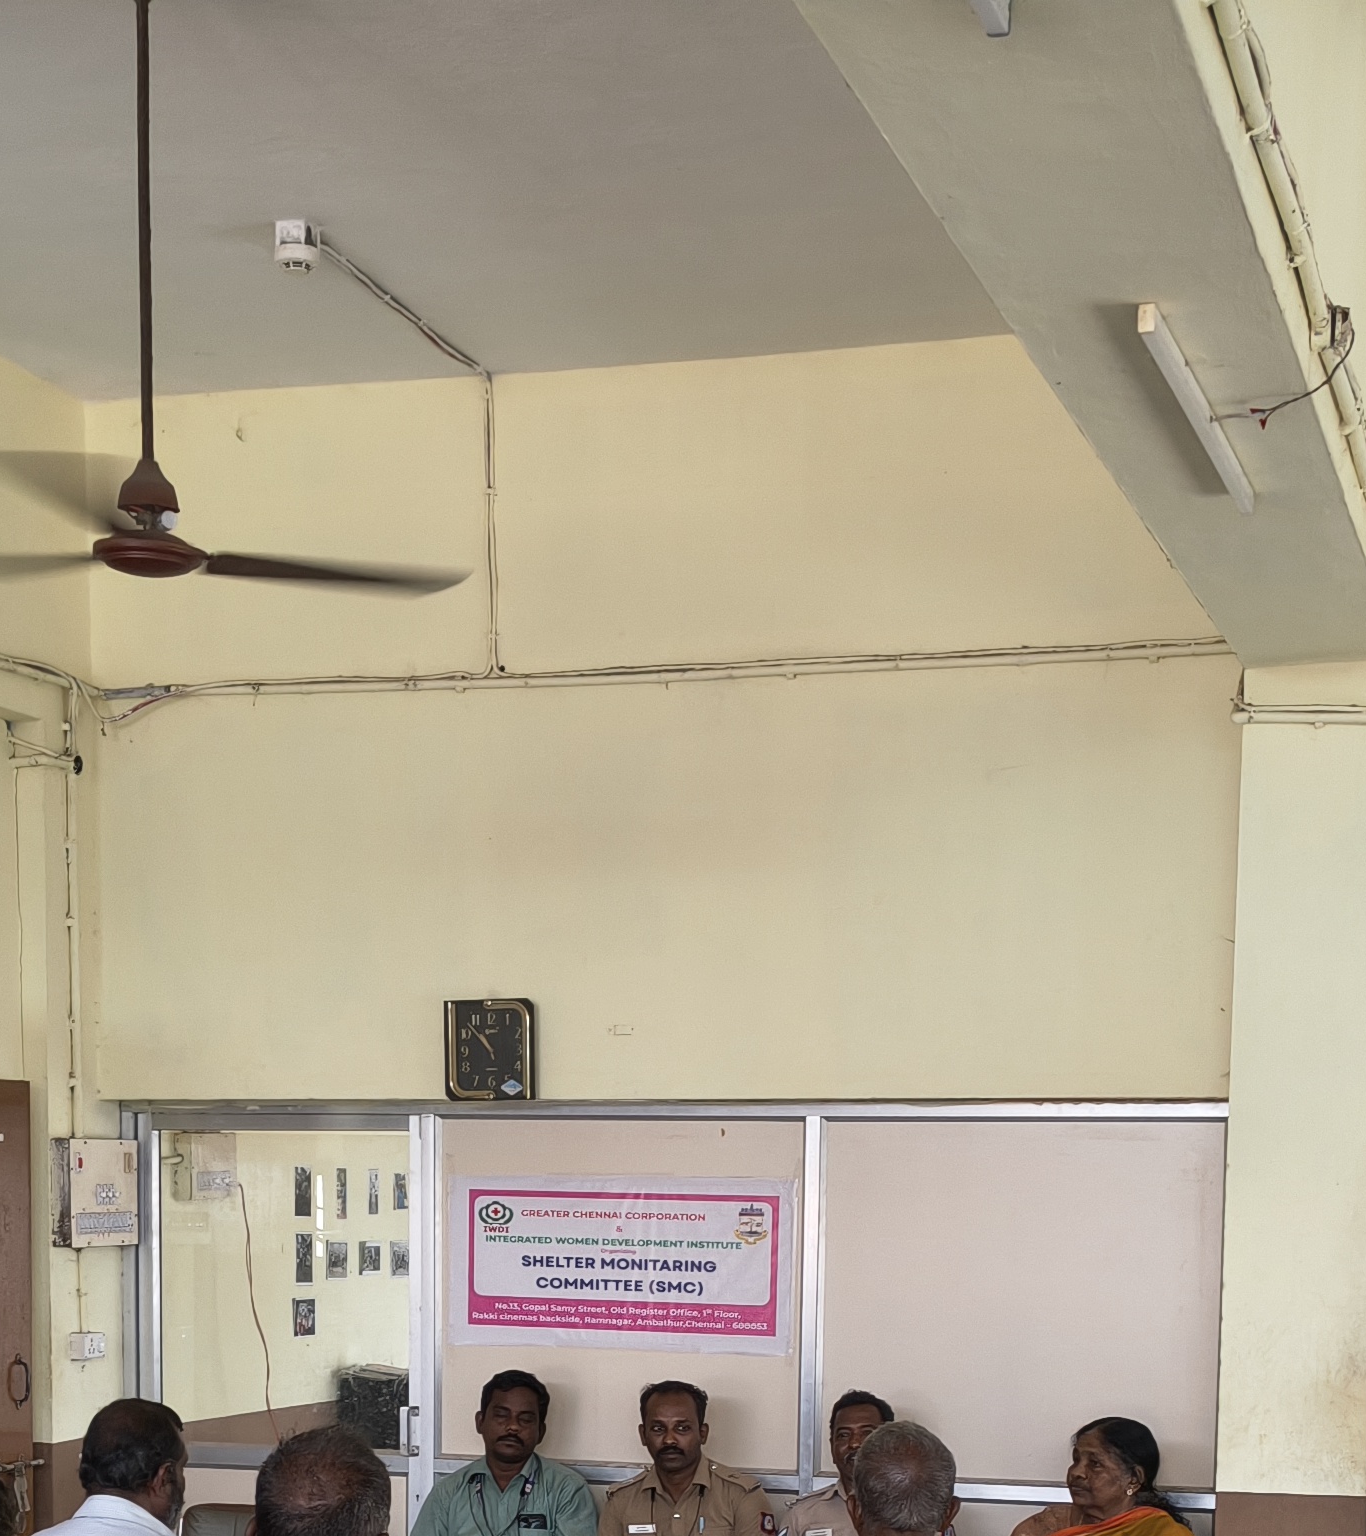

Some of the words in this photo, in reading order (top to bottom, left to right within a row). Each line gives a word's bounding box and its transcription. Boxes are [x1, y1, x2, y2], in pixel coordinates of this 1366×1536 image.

[487, 1011, 496, 1025] 12
[461, 1028, 472, 1040] 10
[514, 1027, 522, 1039] 2
[461, 1045, 469, 1058] 9
[515, 1043, 523, 1056] 3
[461, 1061, 471, 1073] 8
[514, 1060, 522, 1072] 4
[472, 1074, 480, 1088] 7
[487, 1075, 496, 1089] 6
[520, 1209, 570, 1219] GREATER
[572, 1210, 622, 1220] CHENNAI
[624, 1211, 706, 1222] CORPORATION
[483, 1225, 510, 1234] IWDI
[615, 1225, 623, 1233] &
[485, 1234, 553, 1245] INTEGRATED
[555, 1236, 599, 1246] WOMEN
[601, 1237, 685, 1249] DEVELOPMENT
[686, 1240, 743, 1250] INSTITUTE
[521, 1254, 596, 1270] SHELTER
[600, 1257, 717, 1273] MONITARING
[535, 1276, 644, 1292] COMMITTEE
[648, 1279, 704, 1296] (SMC)
[472, 1311, 498, 1320] Rakki
[499, 1312, 538, 1322] cinemas
[521, 1303, 549, 1313] Gopal
[550, 1304, 577, 1313] Samy
[610, 1306, 628, 1314] Old
[628, 1307, 667, 1317] Register
[714, 1310, 742, 1320] Floor,
